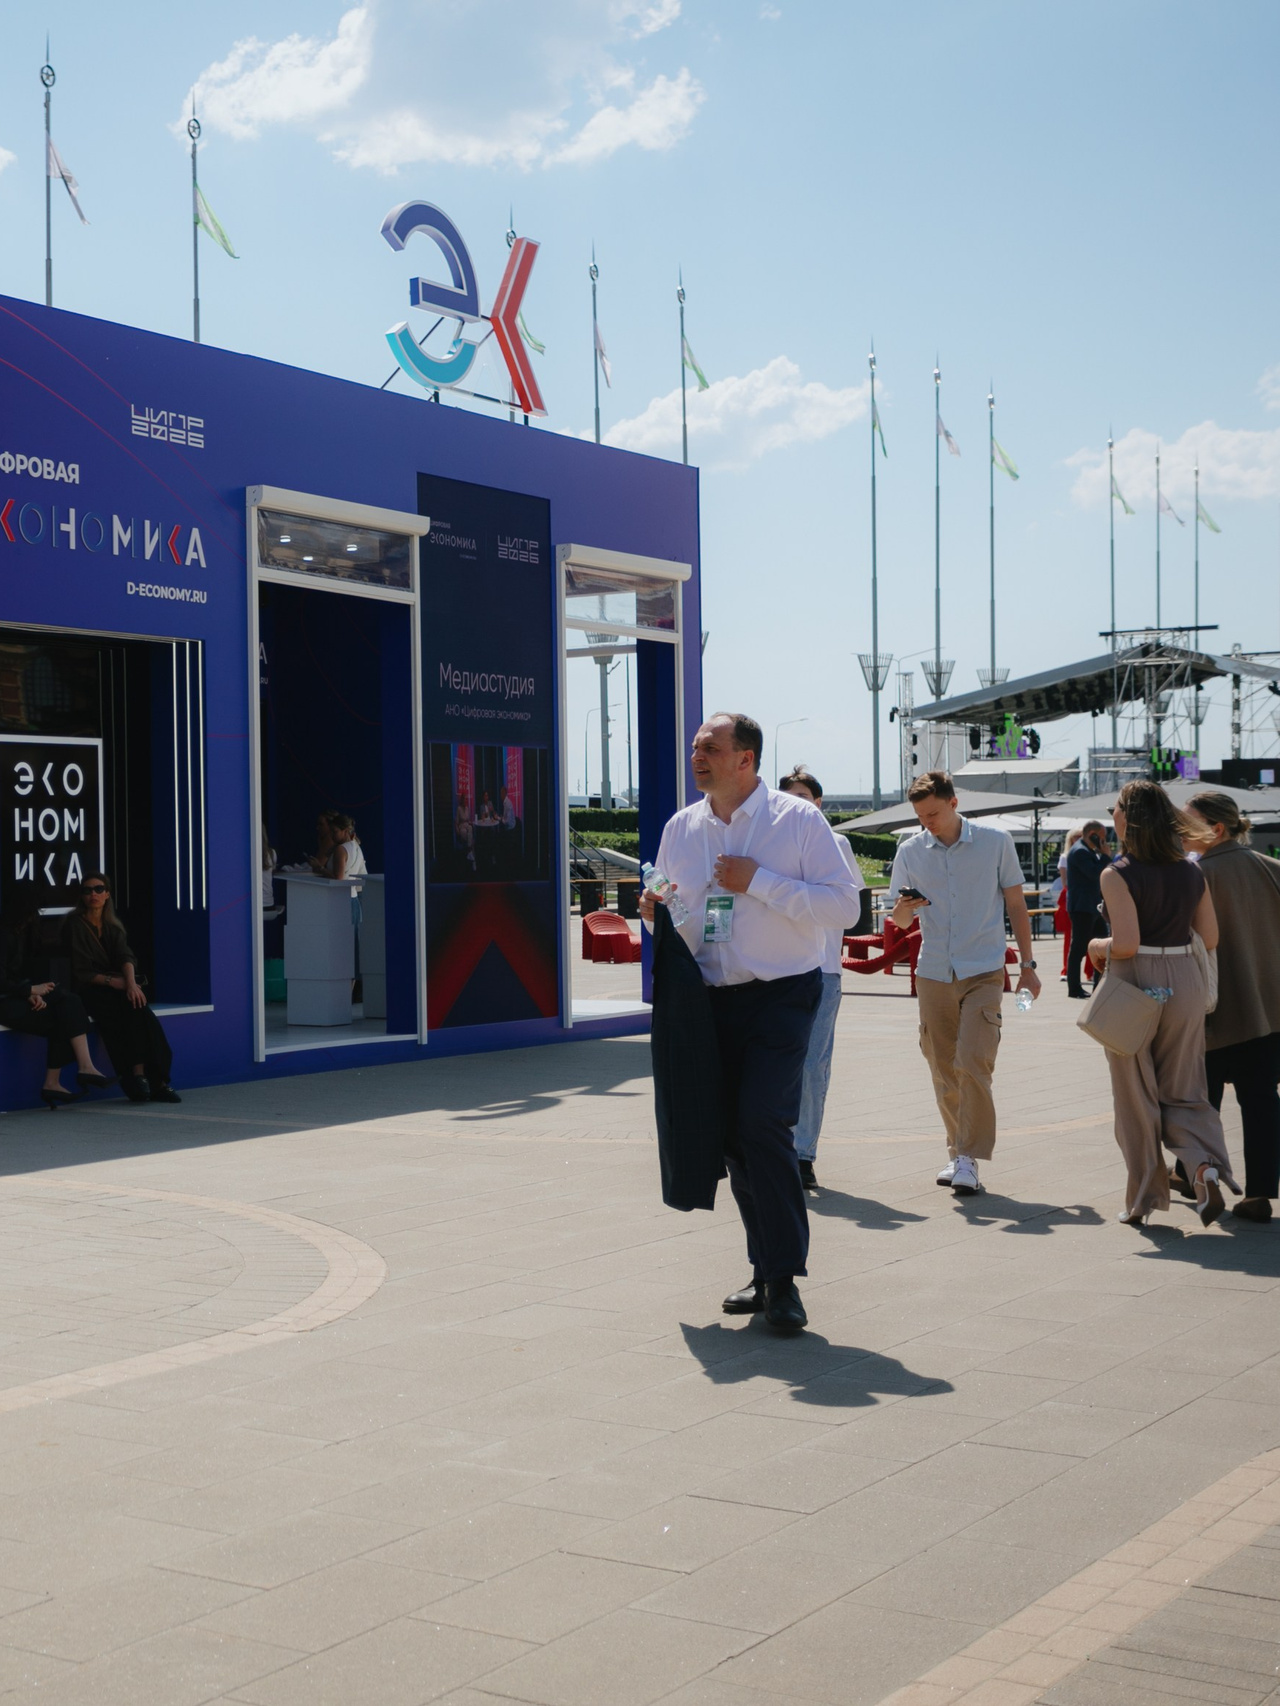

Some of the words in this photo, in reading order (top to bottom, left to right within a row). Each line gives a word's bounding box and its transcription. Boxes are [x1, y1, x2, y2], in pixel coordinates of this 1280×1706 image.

[131, 403, 205, 430] ЦИПР
[131, 419, 205, 449] 2026
[429, 532, 477, 551] ЭКОНОМИКА
[497, 534, 539, 551] ЦИПР
[498, 546, 540, 564] 2026
[126, 581, 208, 604] D-ECONOMY.RU
[439, 662, 535, 700] Медиастудия
[445, 703, 460, 717] АНО
[13, 761, 84, 796] ЭКО
[14, 807, 85, 842] НОМ
[15, 852, 83, 886] ИКА
